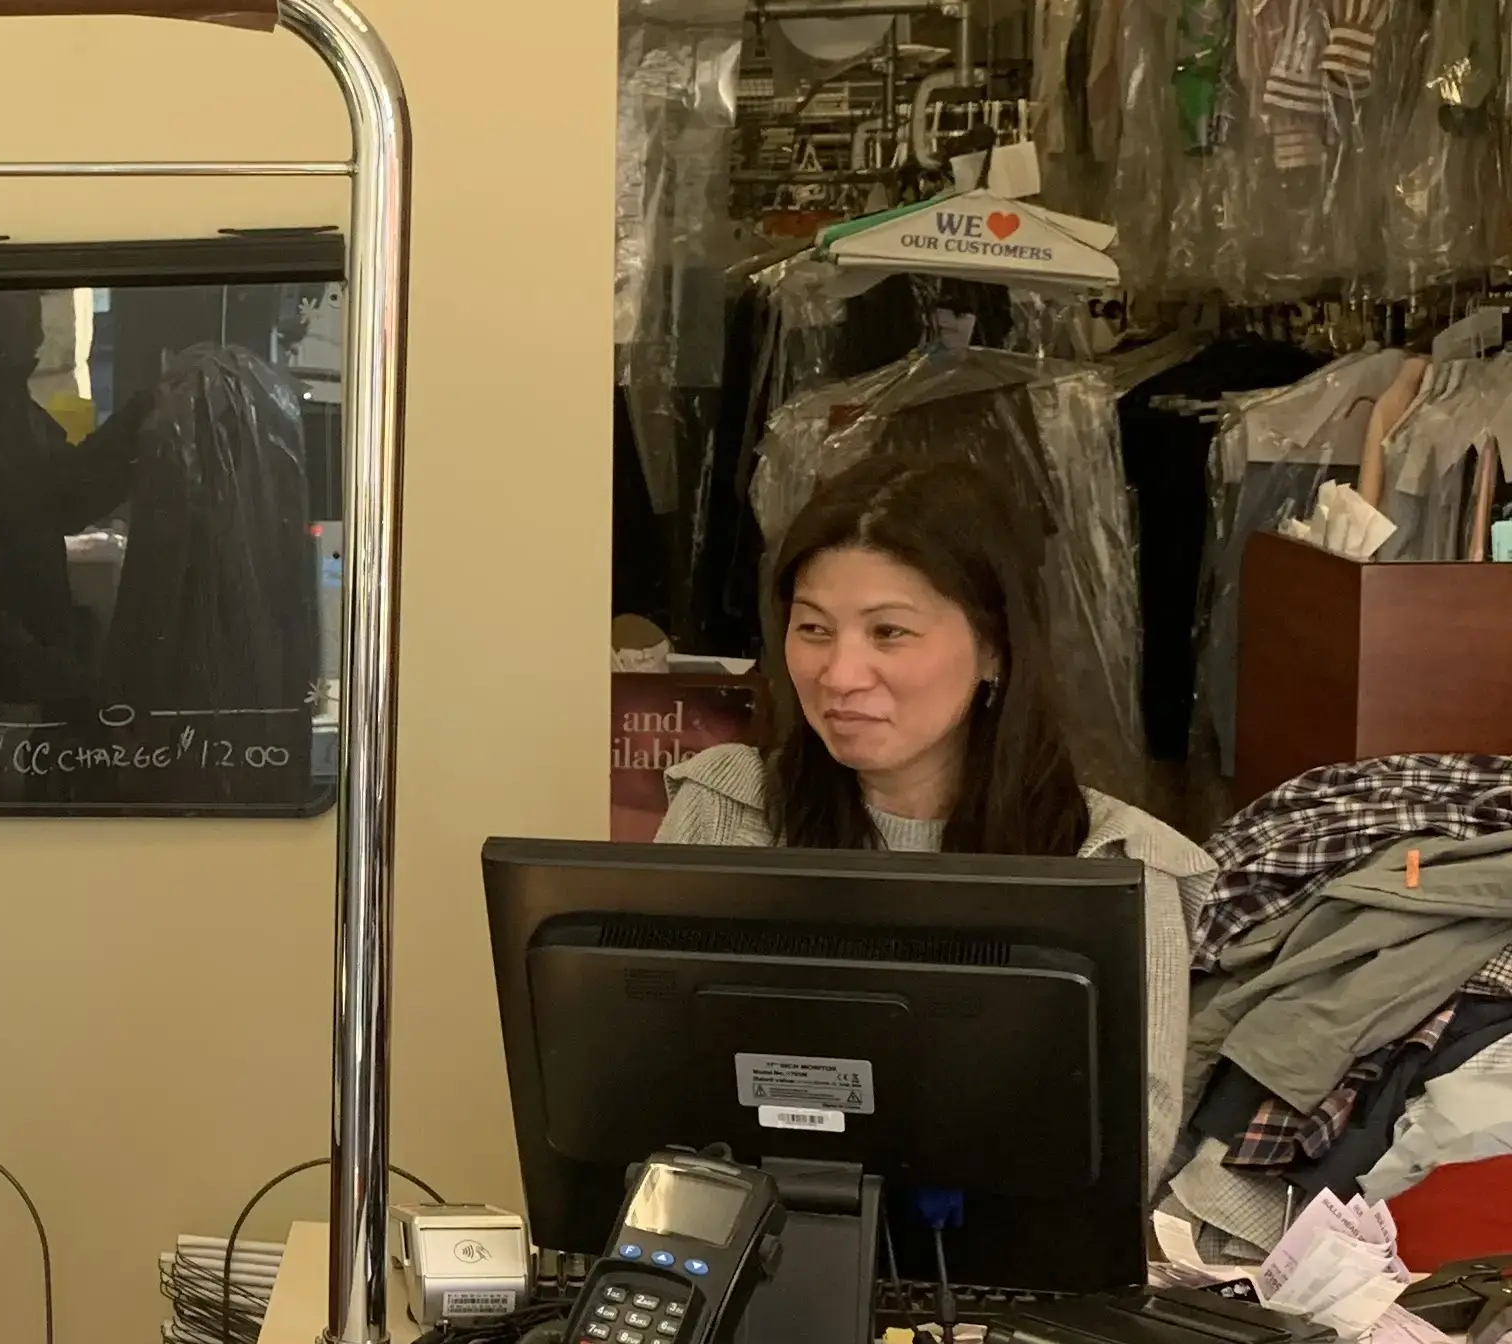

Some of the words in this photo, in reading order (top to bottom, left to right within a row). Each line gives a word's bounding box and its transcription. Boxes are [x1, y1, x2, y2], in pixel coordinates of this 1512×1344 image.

[936, 212, 983, 238] WE
[900, 234, 939, 250] OUR
[944, 238, 1053, 261] CUSTOMERS
[623, 701, 684, 733] and
[612, 736, 696, 770] ilabl
